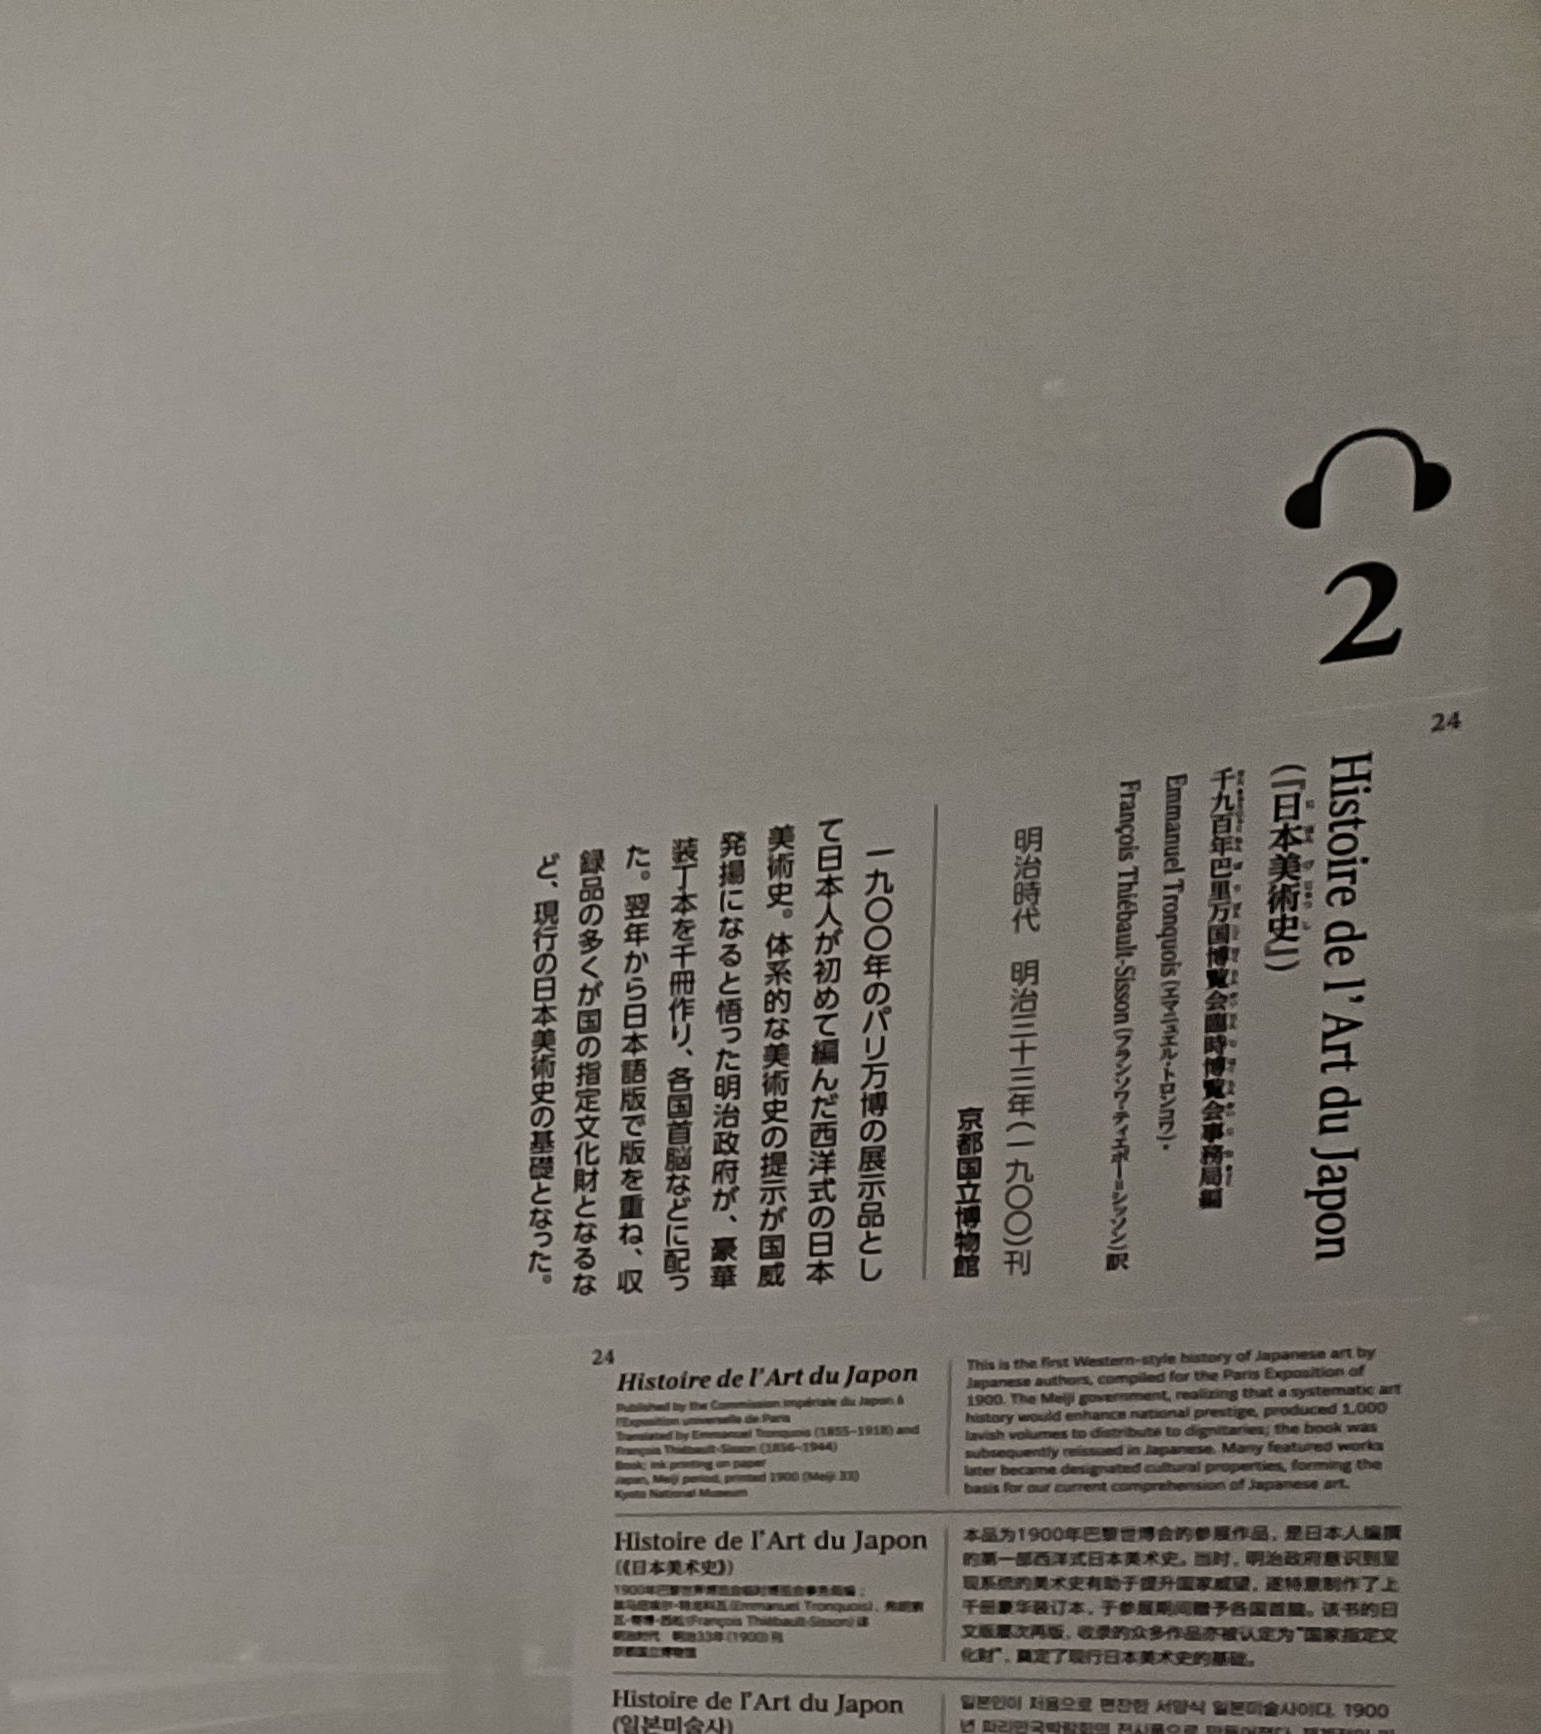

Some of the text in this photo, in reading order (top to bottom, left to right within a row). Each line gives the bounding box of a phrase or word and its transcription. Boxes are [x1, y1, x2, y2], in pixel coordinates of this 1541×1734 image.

[1319, 560, 1403, 665] 2
[1430, 711, 1463, 734] 24
[1114, 779, 1141, 862] François
[1163, 772, 1188, 876] Emmanuel
[1324, 751, 1373, 908] Histoire
[1012, 826, 1043, 934] 明治時代
[1323, 918, 1367, 968] de
[526, 853, 560, 1285] ど、現行の日本美術史の基礎となった。
[571, 848, 605, 1297] 録品の多くが国の指定文化財となるな
[616, 844, 651, 1295] た。翌年から日本語版で版を重ね、収
[663, 836, 699, 1292] 装丁本を千冊作り、各国首脳などに配っ
[709, 831, 747, 1290] 発揚になると悟った明治政府が、豪華
[757, 824, 795, 1289] 美術史。体系的な美術史の提示が国威
[805, 818, 844, 1286] て日本人が初めて編んだ西洋式の日本
[1318, 1084, 1362, 1136] du
[953, 1106, 984, 1279] 京都国立博物館
[1304, 1145, 1359, 1262] Japon
[592, 1349, 615, 1366] 24
[616, 1372, 712, 1391] Histoire
[716, 1368, 744, 1388] de
[809, 1365, 840, 1385] du
[843, 1366, 918, 1388] Japon
[614, 1531, 707, 1551] Histoire
[714, 1531, 743, 1551] de
[814, 1529, 845, 1550] du
[852, 1530, 928, 1555] Japon
[612, 1689, 698, 1709] Histoire
[705, 1691, 733, 1711] de
[799, 1693, 828, 1713] du
[834, 1694, 904, 1718] Japon
[1344, 1703, 1389, 1719] 1900
